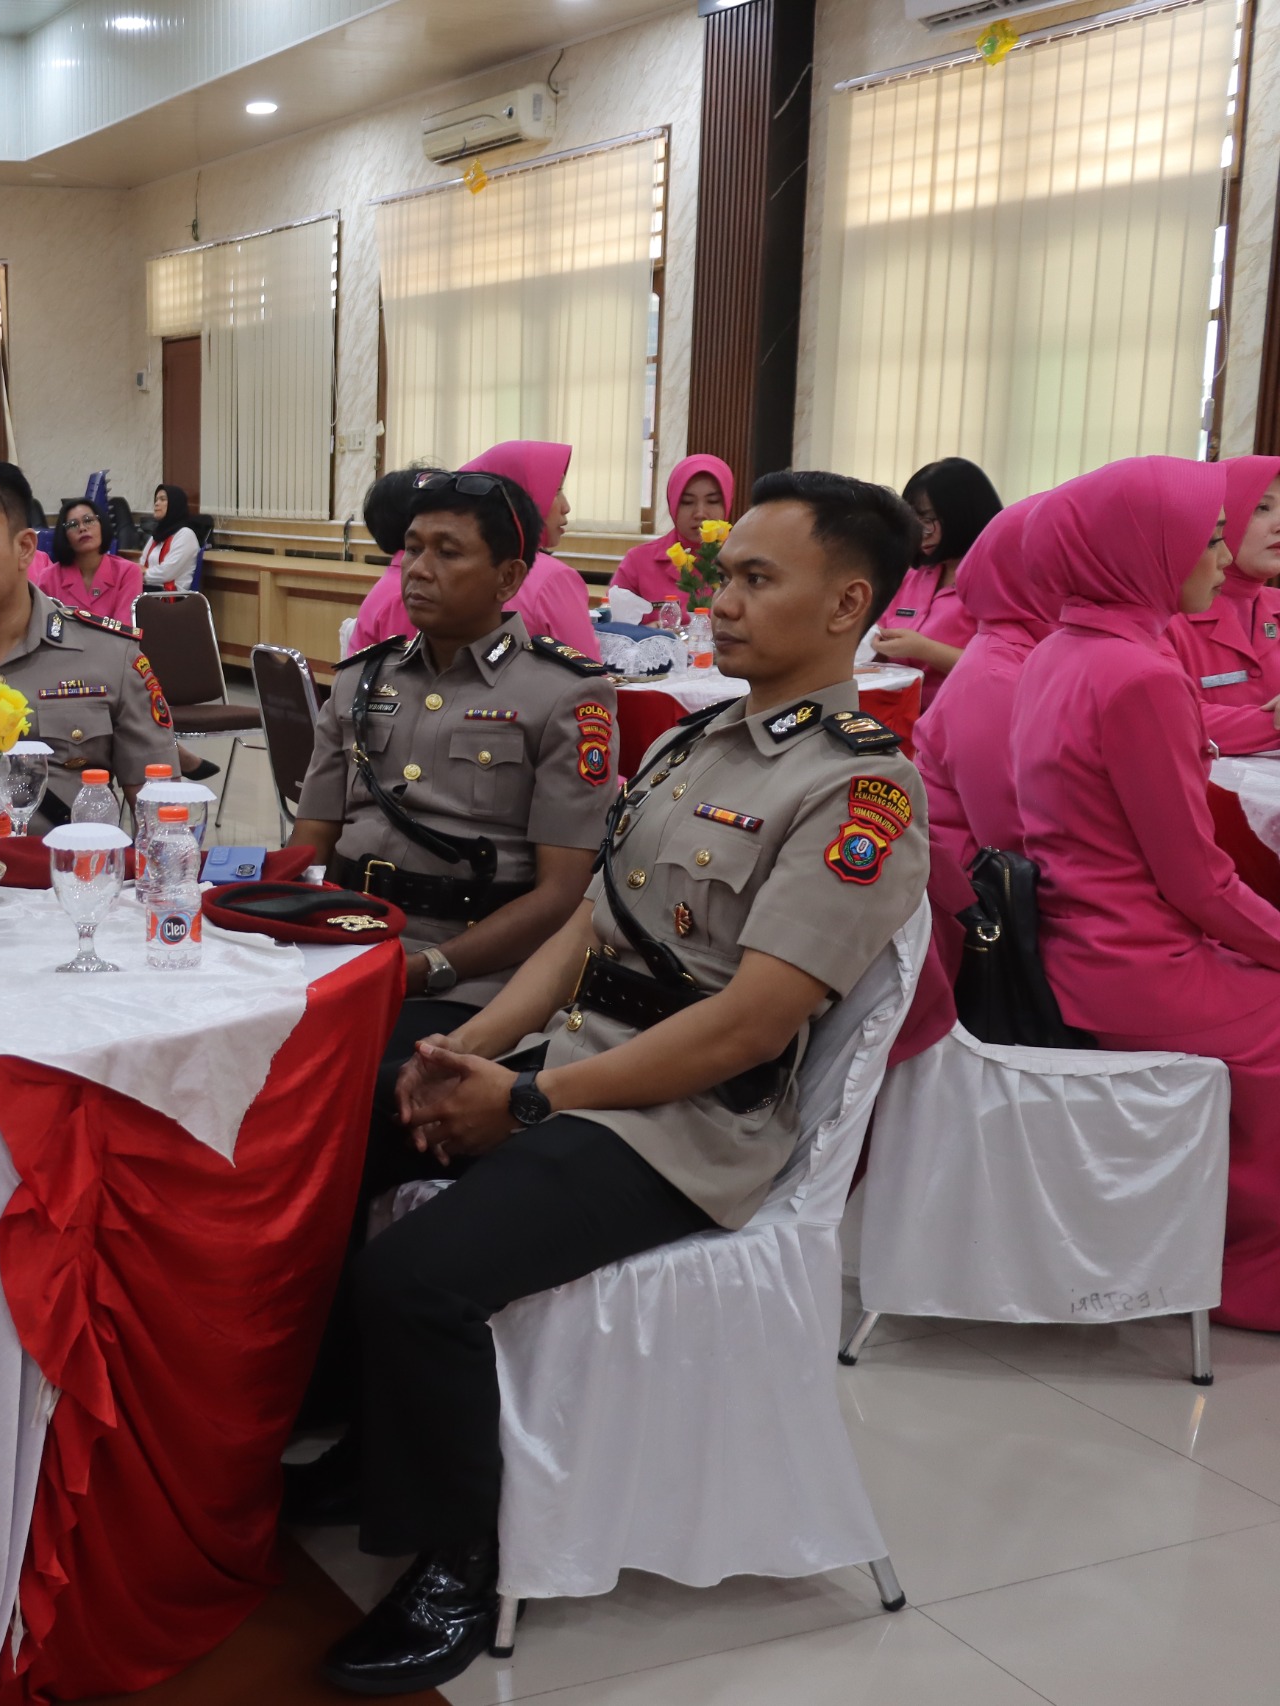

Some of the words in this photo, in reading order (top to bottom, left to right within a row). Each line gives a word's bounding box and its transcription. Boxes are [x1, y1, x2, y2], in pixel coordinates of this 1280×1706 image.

[579, 705, 609, 720] POLDA
[854, 791, 886, 806] PEMATANG
[857, 780, 911, 818] POLRES
[853, 806, 883, 824] SUMATERA
[880, 819, 898, 835] UTARA
[165, 922, 186, 936] Cleo
